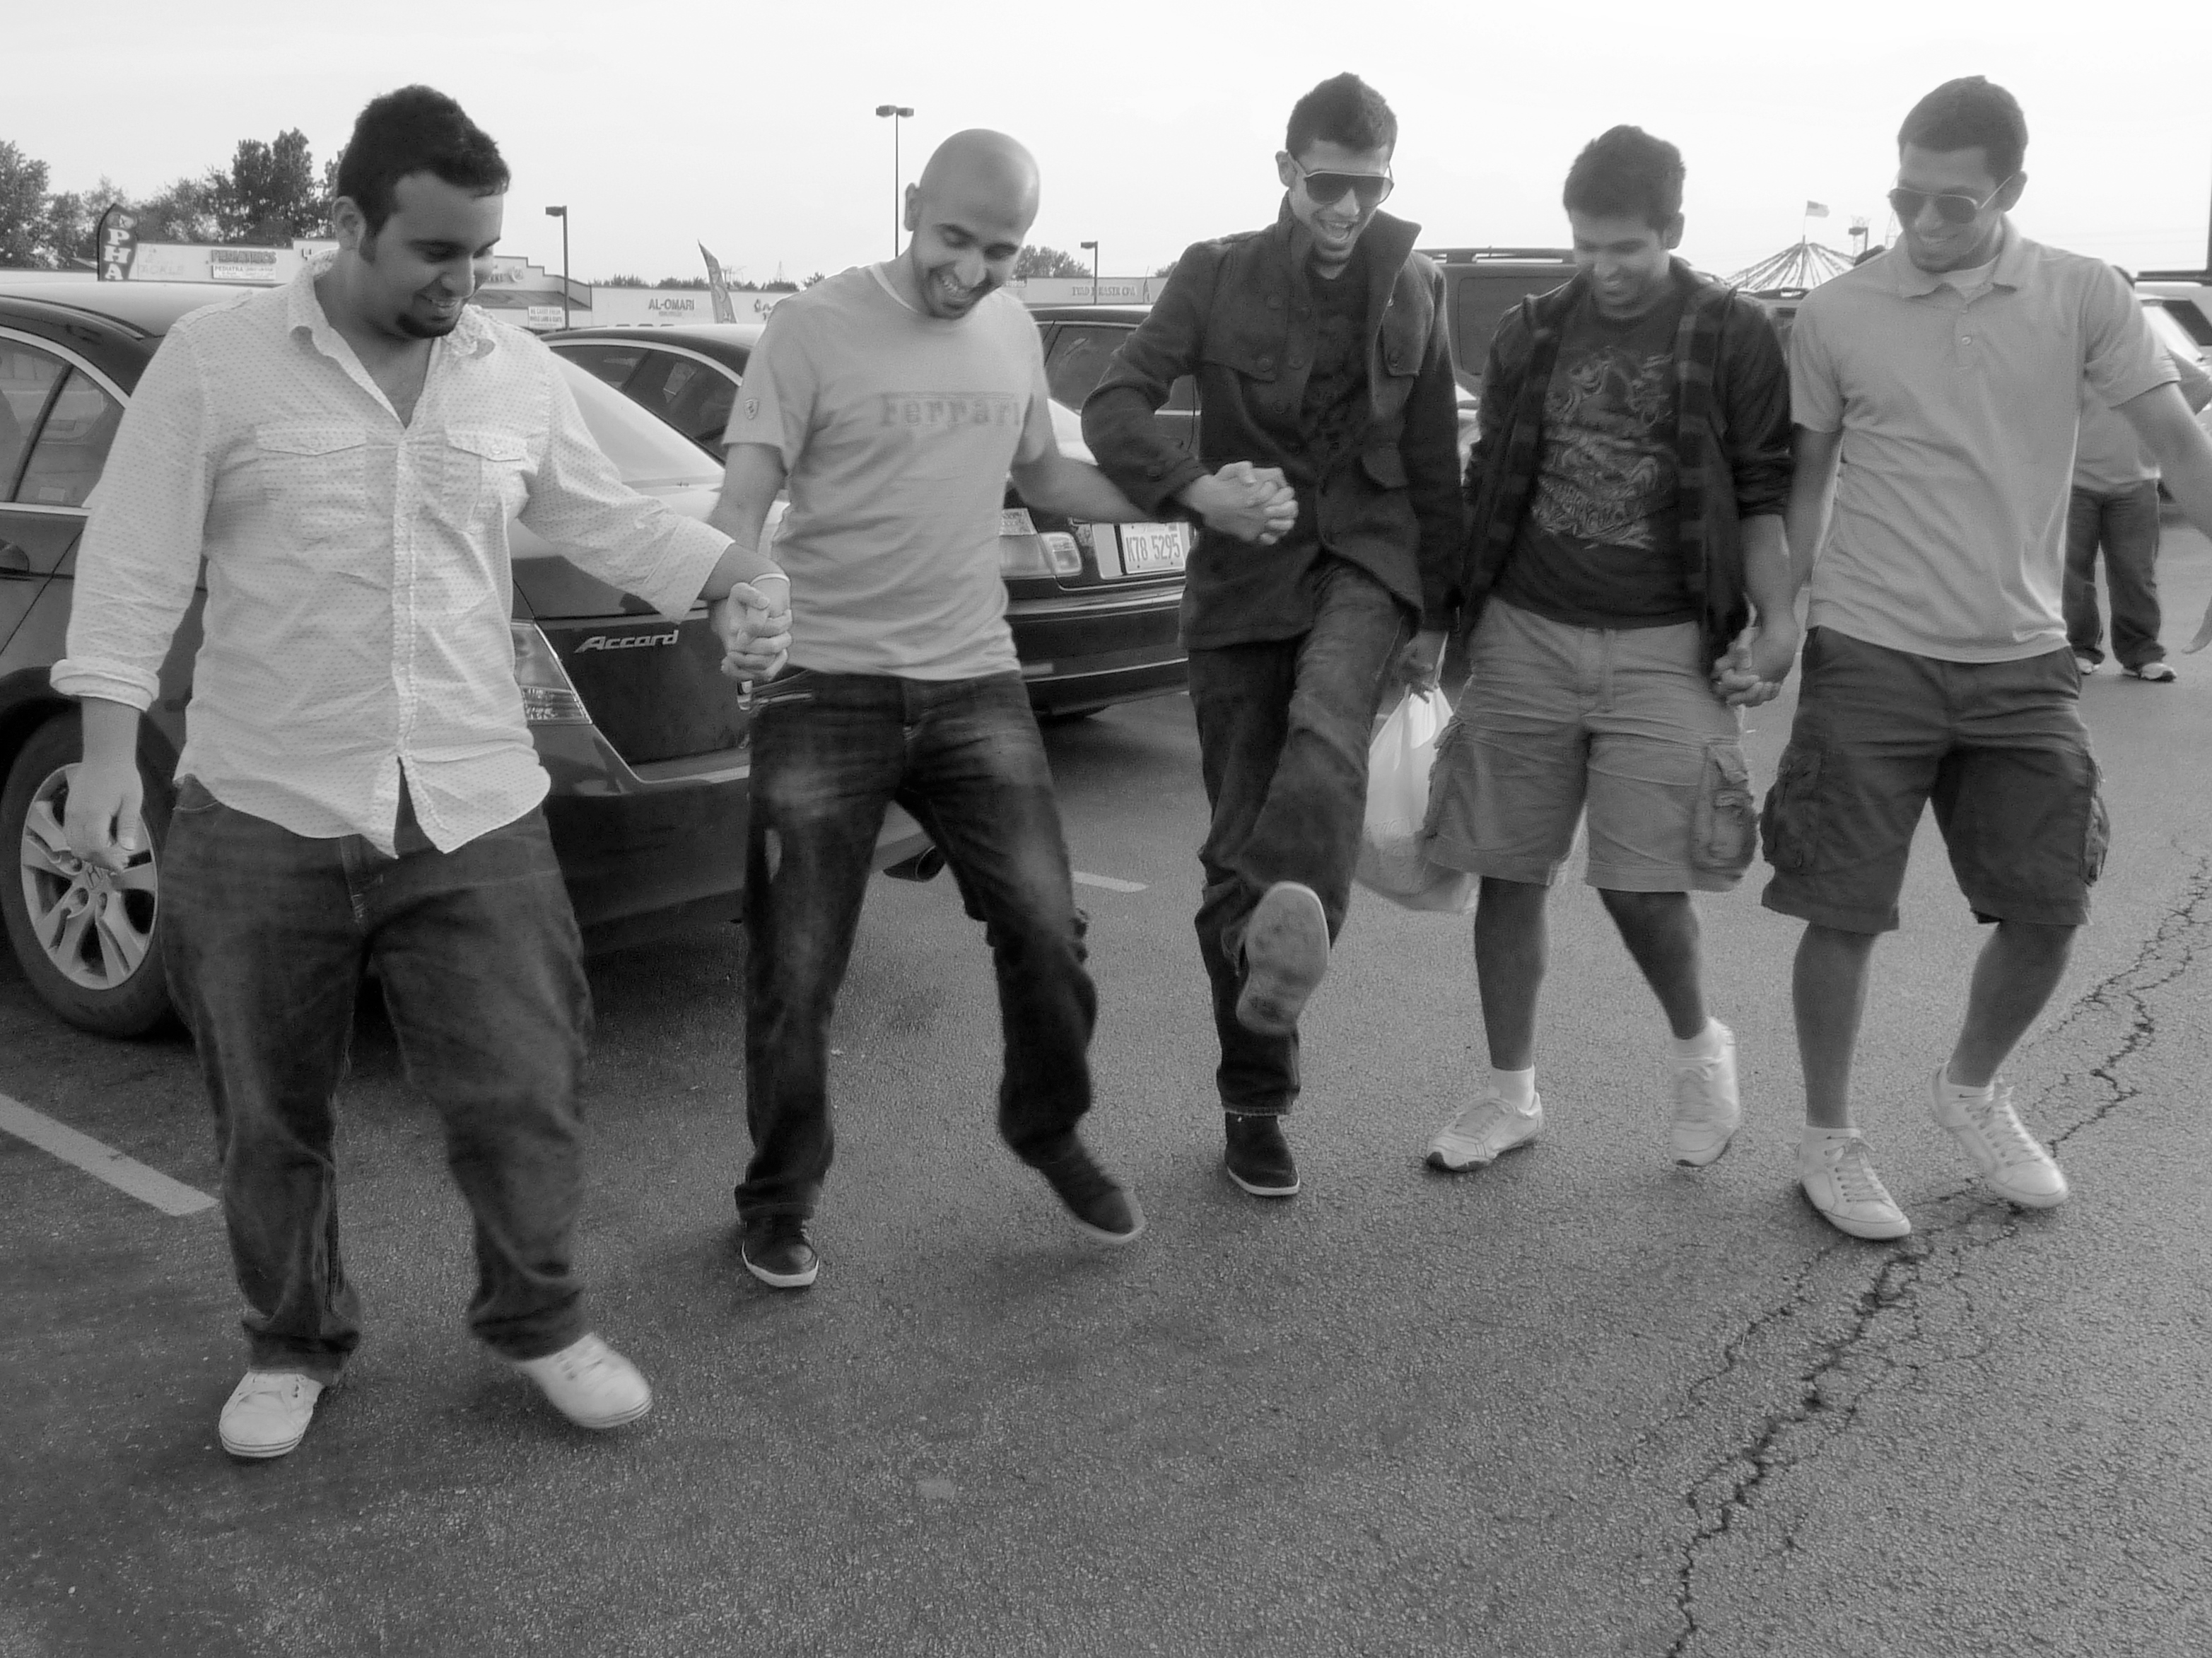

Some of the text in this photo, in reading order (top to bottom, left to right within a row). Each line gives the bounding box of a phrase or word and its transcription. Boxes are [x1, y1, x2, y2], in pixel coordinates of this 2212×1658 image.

[211, 250, 277, 264] PEDIATRICS
[648, 298, 695, 310] AL-OMARI
[877, 392, 1021, 427] Ferrari
[1125, 534, 1180, 562] K78 5295
[574, 629, 679, 653] Accord
